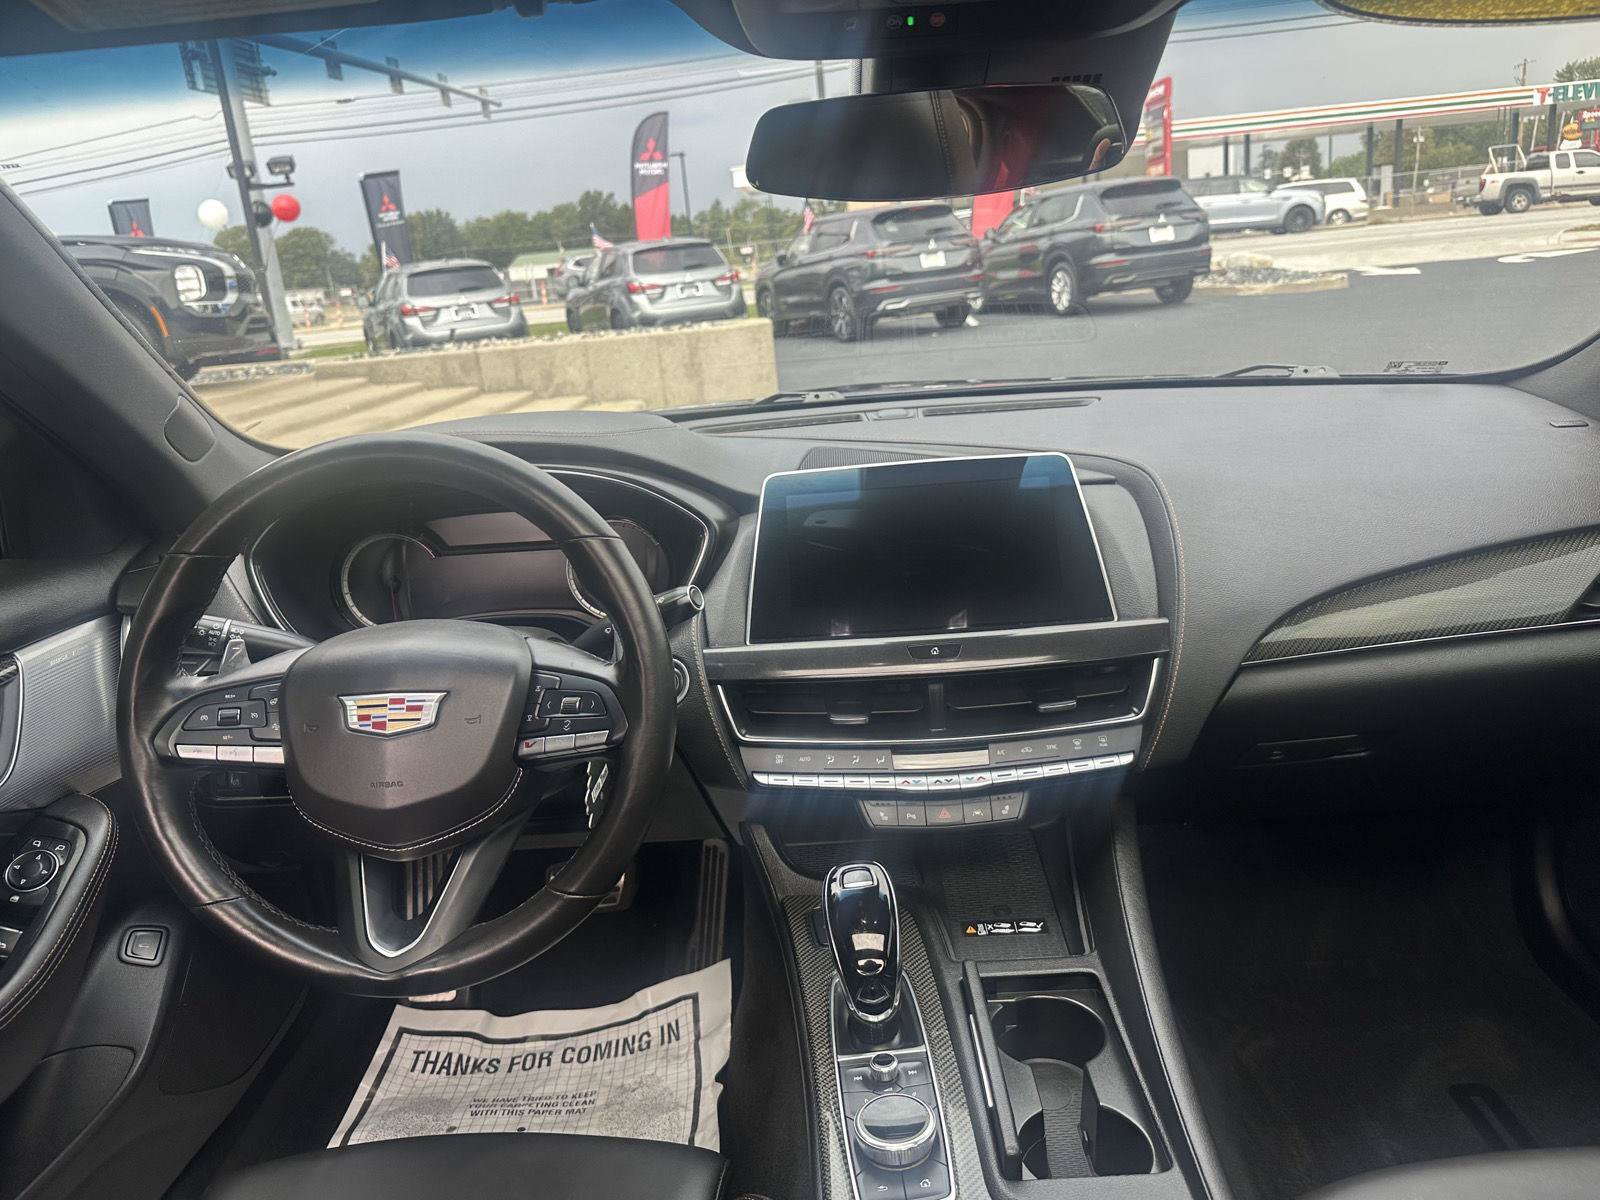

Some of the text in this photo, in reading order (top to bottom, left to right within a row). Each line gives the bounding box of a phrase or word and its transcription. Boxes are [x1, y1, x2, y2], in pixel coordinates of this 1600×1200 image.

[1537, 82, 1600, 105] 7-ELEV
[370, 780, 404, 789] AIRBAG
[410, 1018, 681, 1076] THANKS FOR COMING IN
[571, 1089, 597, 1100] KEEP
[562, 1099, 596, 1108] CLEAN
[470, 1109, 498, 1117] WITH
[527, 1108, 562, 1116] PAPER
[565, 1107, 587, 1115] MAT
